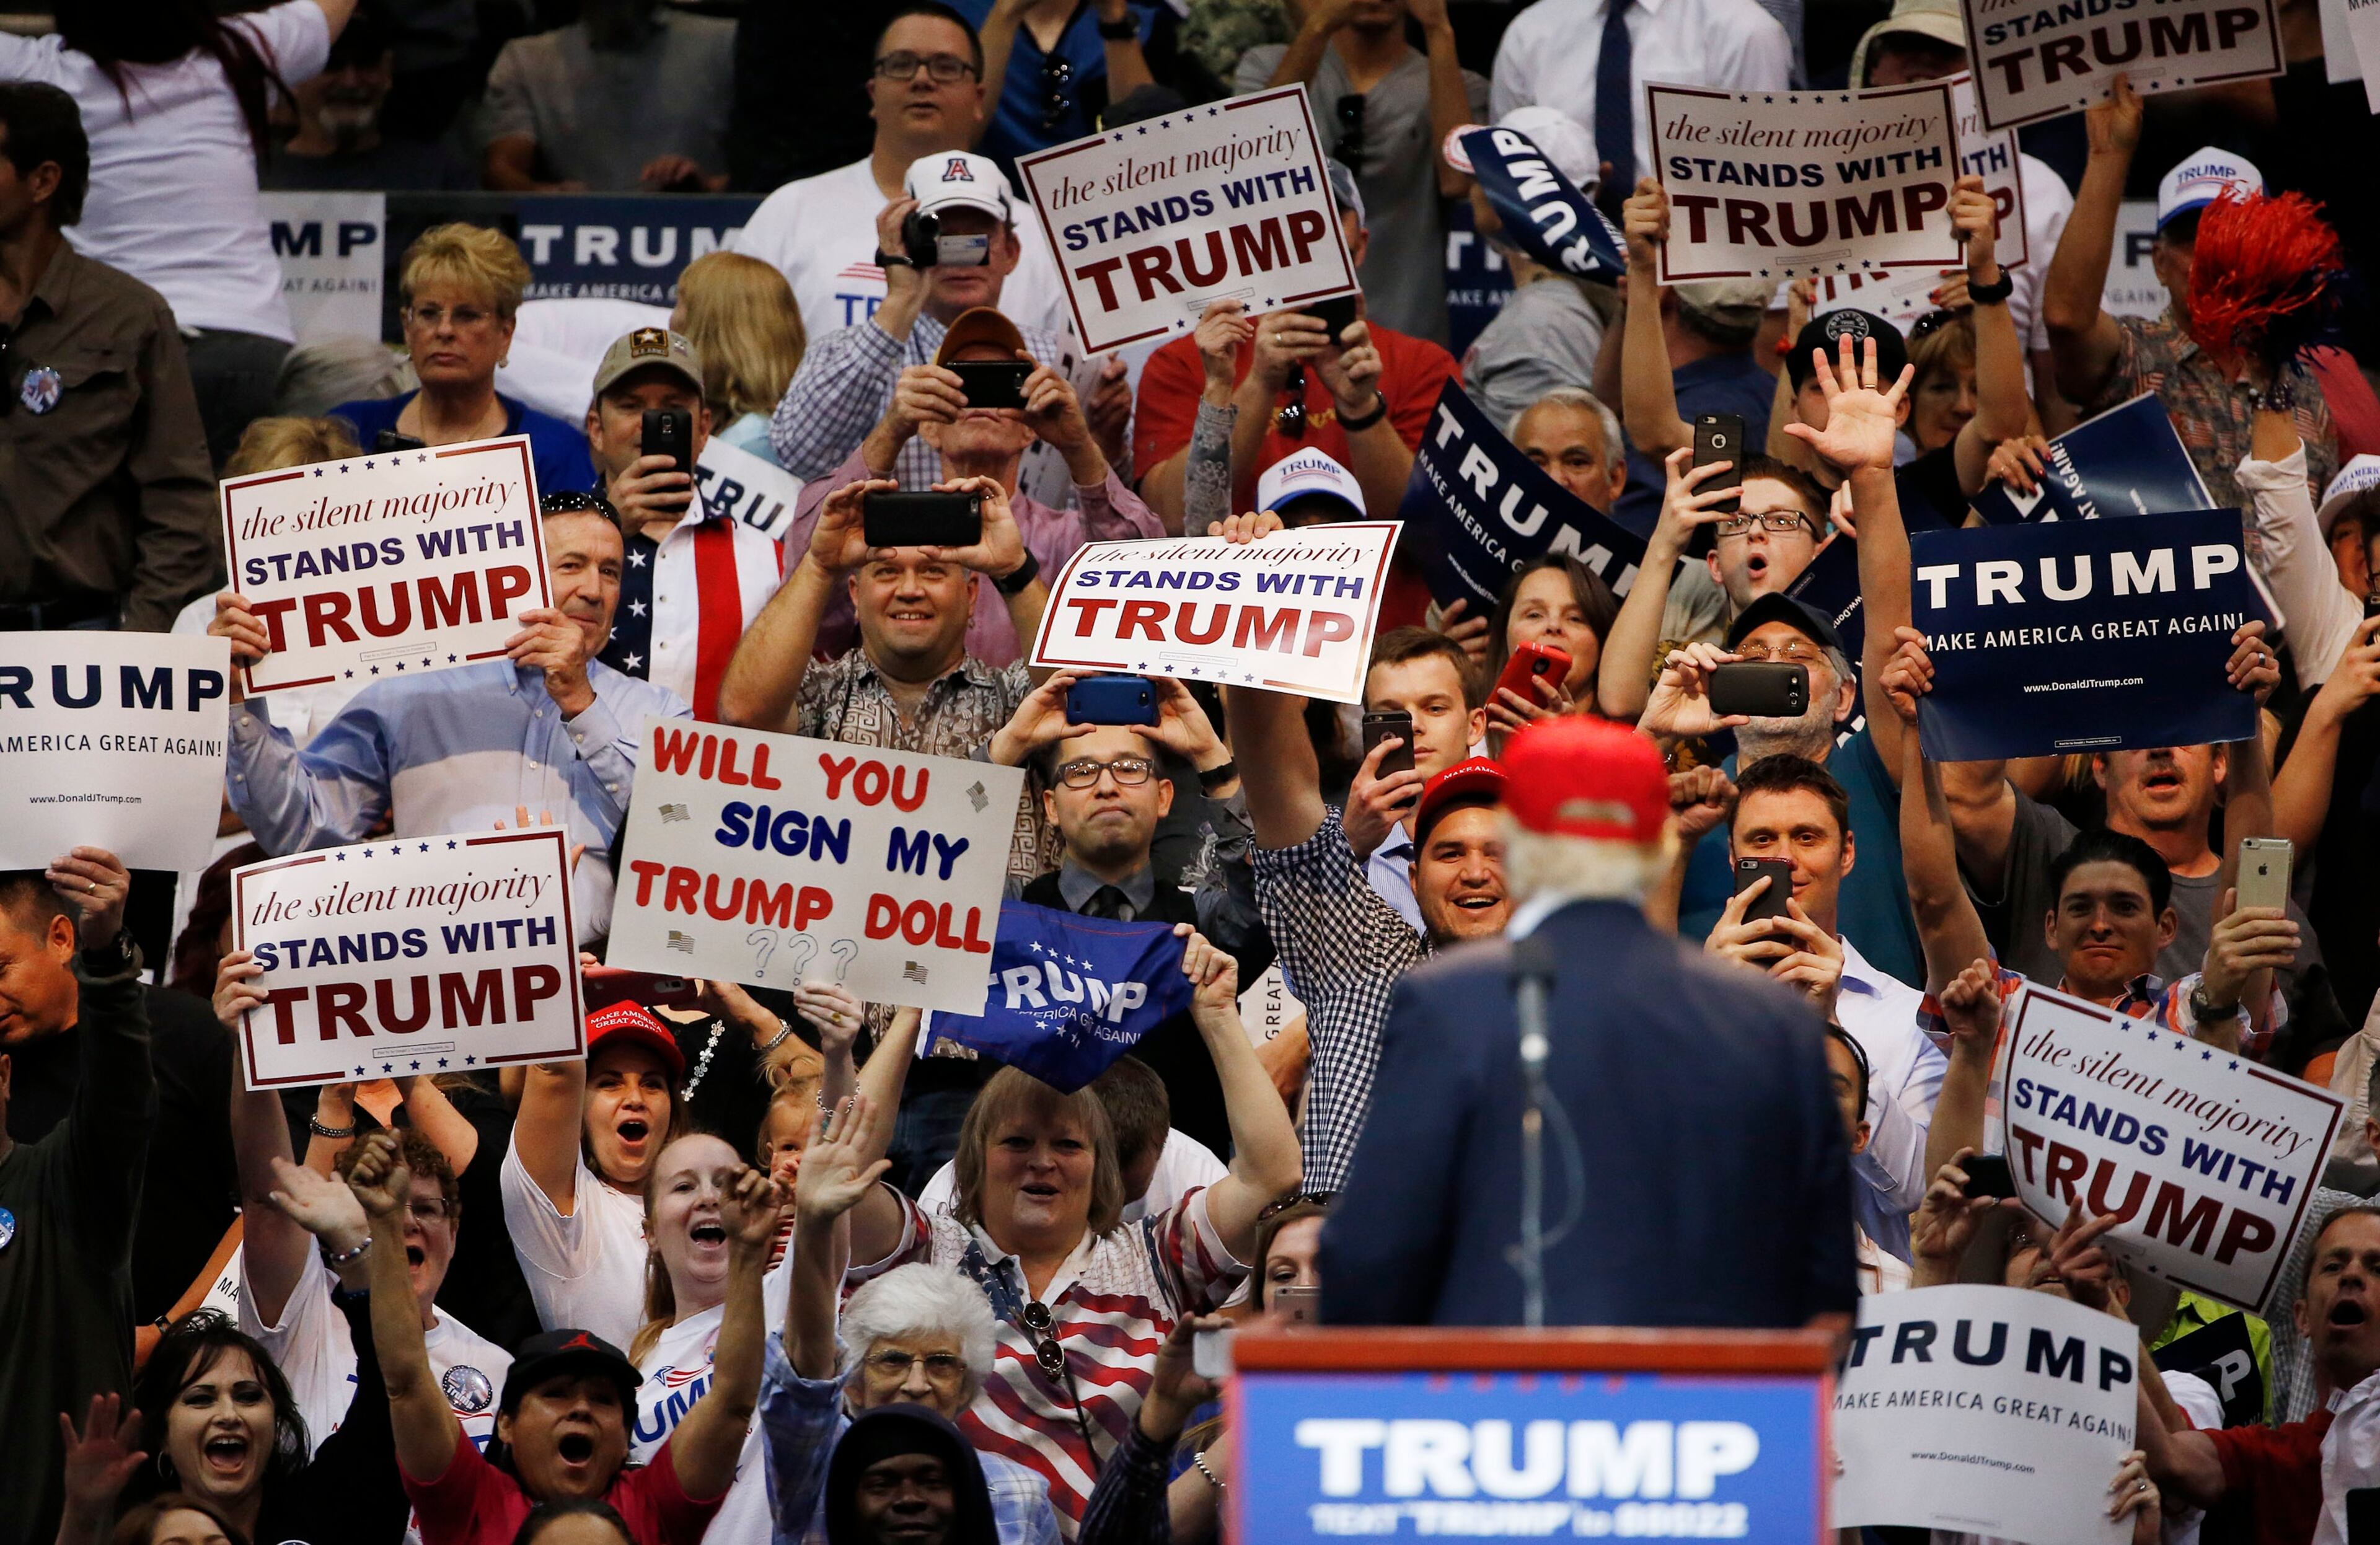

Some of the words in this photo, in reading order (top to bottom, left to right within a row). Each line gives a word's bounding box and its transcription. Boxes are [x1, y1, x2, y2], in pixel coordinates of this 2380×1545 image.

[1987, 7, 2261, 95] TRUMP
[1665, 114, 1711, 144] the
[1716, 113, 1796, 149] silent
[1804, 110, 1938, 154] majority
[1961, 142, 2008, 178] ITH
[1052, 177, 1095, 211] the
[1102, 154, 1178, 198] silent
[1186, 125, 1301, 175] majority
[1668, 156, 1826, 188] STANDS
[1836, 146, 1942, 185] WITH
[2177, 164, 2237, 185] TRUMP
[1062, 188, 1214, 252] STANDS
[1220, 165, 1316, 209] WITH
[1672, 181, 1948, 248] TRUMP
[521, 225, 742, 268] TRUM
[1075, 209, 1328, 313] TRUMP
[312, 280, 377, 294] AGAIN!
[577, 282, 664, 302] AMERICA
[1446, 289, 1484, 307] AKE
[1279, 459, 1341, 475] TRUMP
[242, 506, 284, 542] the
[291, 497, 374, 533] silent
[382, 475, 517, 534] majority
[1418, 448, 1448, 497] MAKE
[1445, 494, 1507, 564] AMERICA
[1434, 402, 1641, 599] TRUM
[245, 537, 406, 586] STANDS
[416, 519, 524, 561] WITH
[1087, 548, 1139, 563] the
[1142, 543, 1232, 562] silent
[1238, 541, 1373, 569] majority
[1917, 544, 2240, 609] TRUMP
[250, 565, 532, 654] TRUMP
[1076, 570, 1241, 592] STANDS
[1256, 573, 1364, 599] WITH
[1066, 597, 1355, 658] TRUMP
[1983, 624, 2084, 649] AMERICA
[2091, 619, 2160, 640] GREAT
[2167, 612, 2245, 635] AGAIN!
[0, 664, 224, 713] RUMP
[2023, 675, 2143, 693] www.DonaldJTrump.com
[100, 735, 159, 753] GREAT
[164, 737, 222, 757] AGAIN!
[654, 726, 781, 790] WILL
[819, 752, 930, 812] YOU
[30, 793, 142, 805] www.DonaldJTrump.com
[715, 801, 852, 865] SIGN
[886, 826, 969, 881] MY
[252, 891, 301, 926] the
[308, 881, 399, 917] silent
[408, 868, 551, 915] majority
[630, 860, 833, 932] TRUMP
[865, 894, 991, 954] DOLL
[252, 928, 428, 972] STANDS
[443, 916, 557, 953] WITH
[267, 964, 561, 1046] TRUMP
[590, 1011, 619, 1024] MAKE
[621, 1010, 662, 1032] AMERICA
[596, 1018, 628, 1028] GREAT
[1265, 977, 1281, 1041] GREAT
[2024, 1028, 2066, 1068] the
[2071, 1050, 2166, 1101] silent
[2169, 1086, 2314, 1159] majority
[2014, 1077, 2169, 1156] STANDS
[2181, 1137, 2297, 1207] WITH
[2011, 1122, 2277, 1267] TRUMP
[1851, 1319, 2133, 1393] TRUMP
[1887, 1390, 1983, 1411] AMERICA
[1993, 1396, 2063, 1424] GREAT
[2069, 1413, 2132, 1445] AGAIN!
[1295, 1419, 1759, 1499] TRUMP
[1911, 1450, 2035, 1474] www.DonaldJTrump.com
